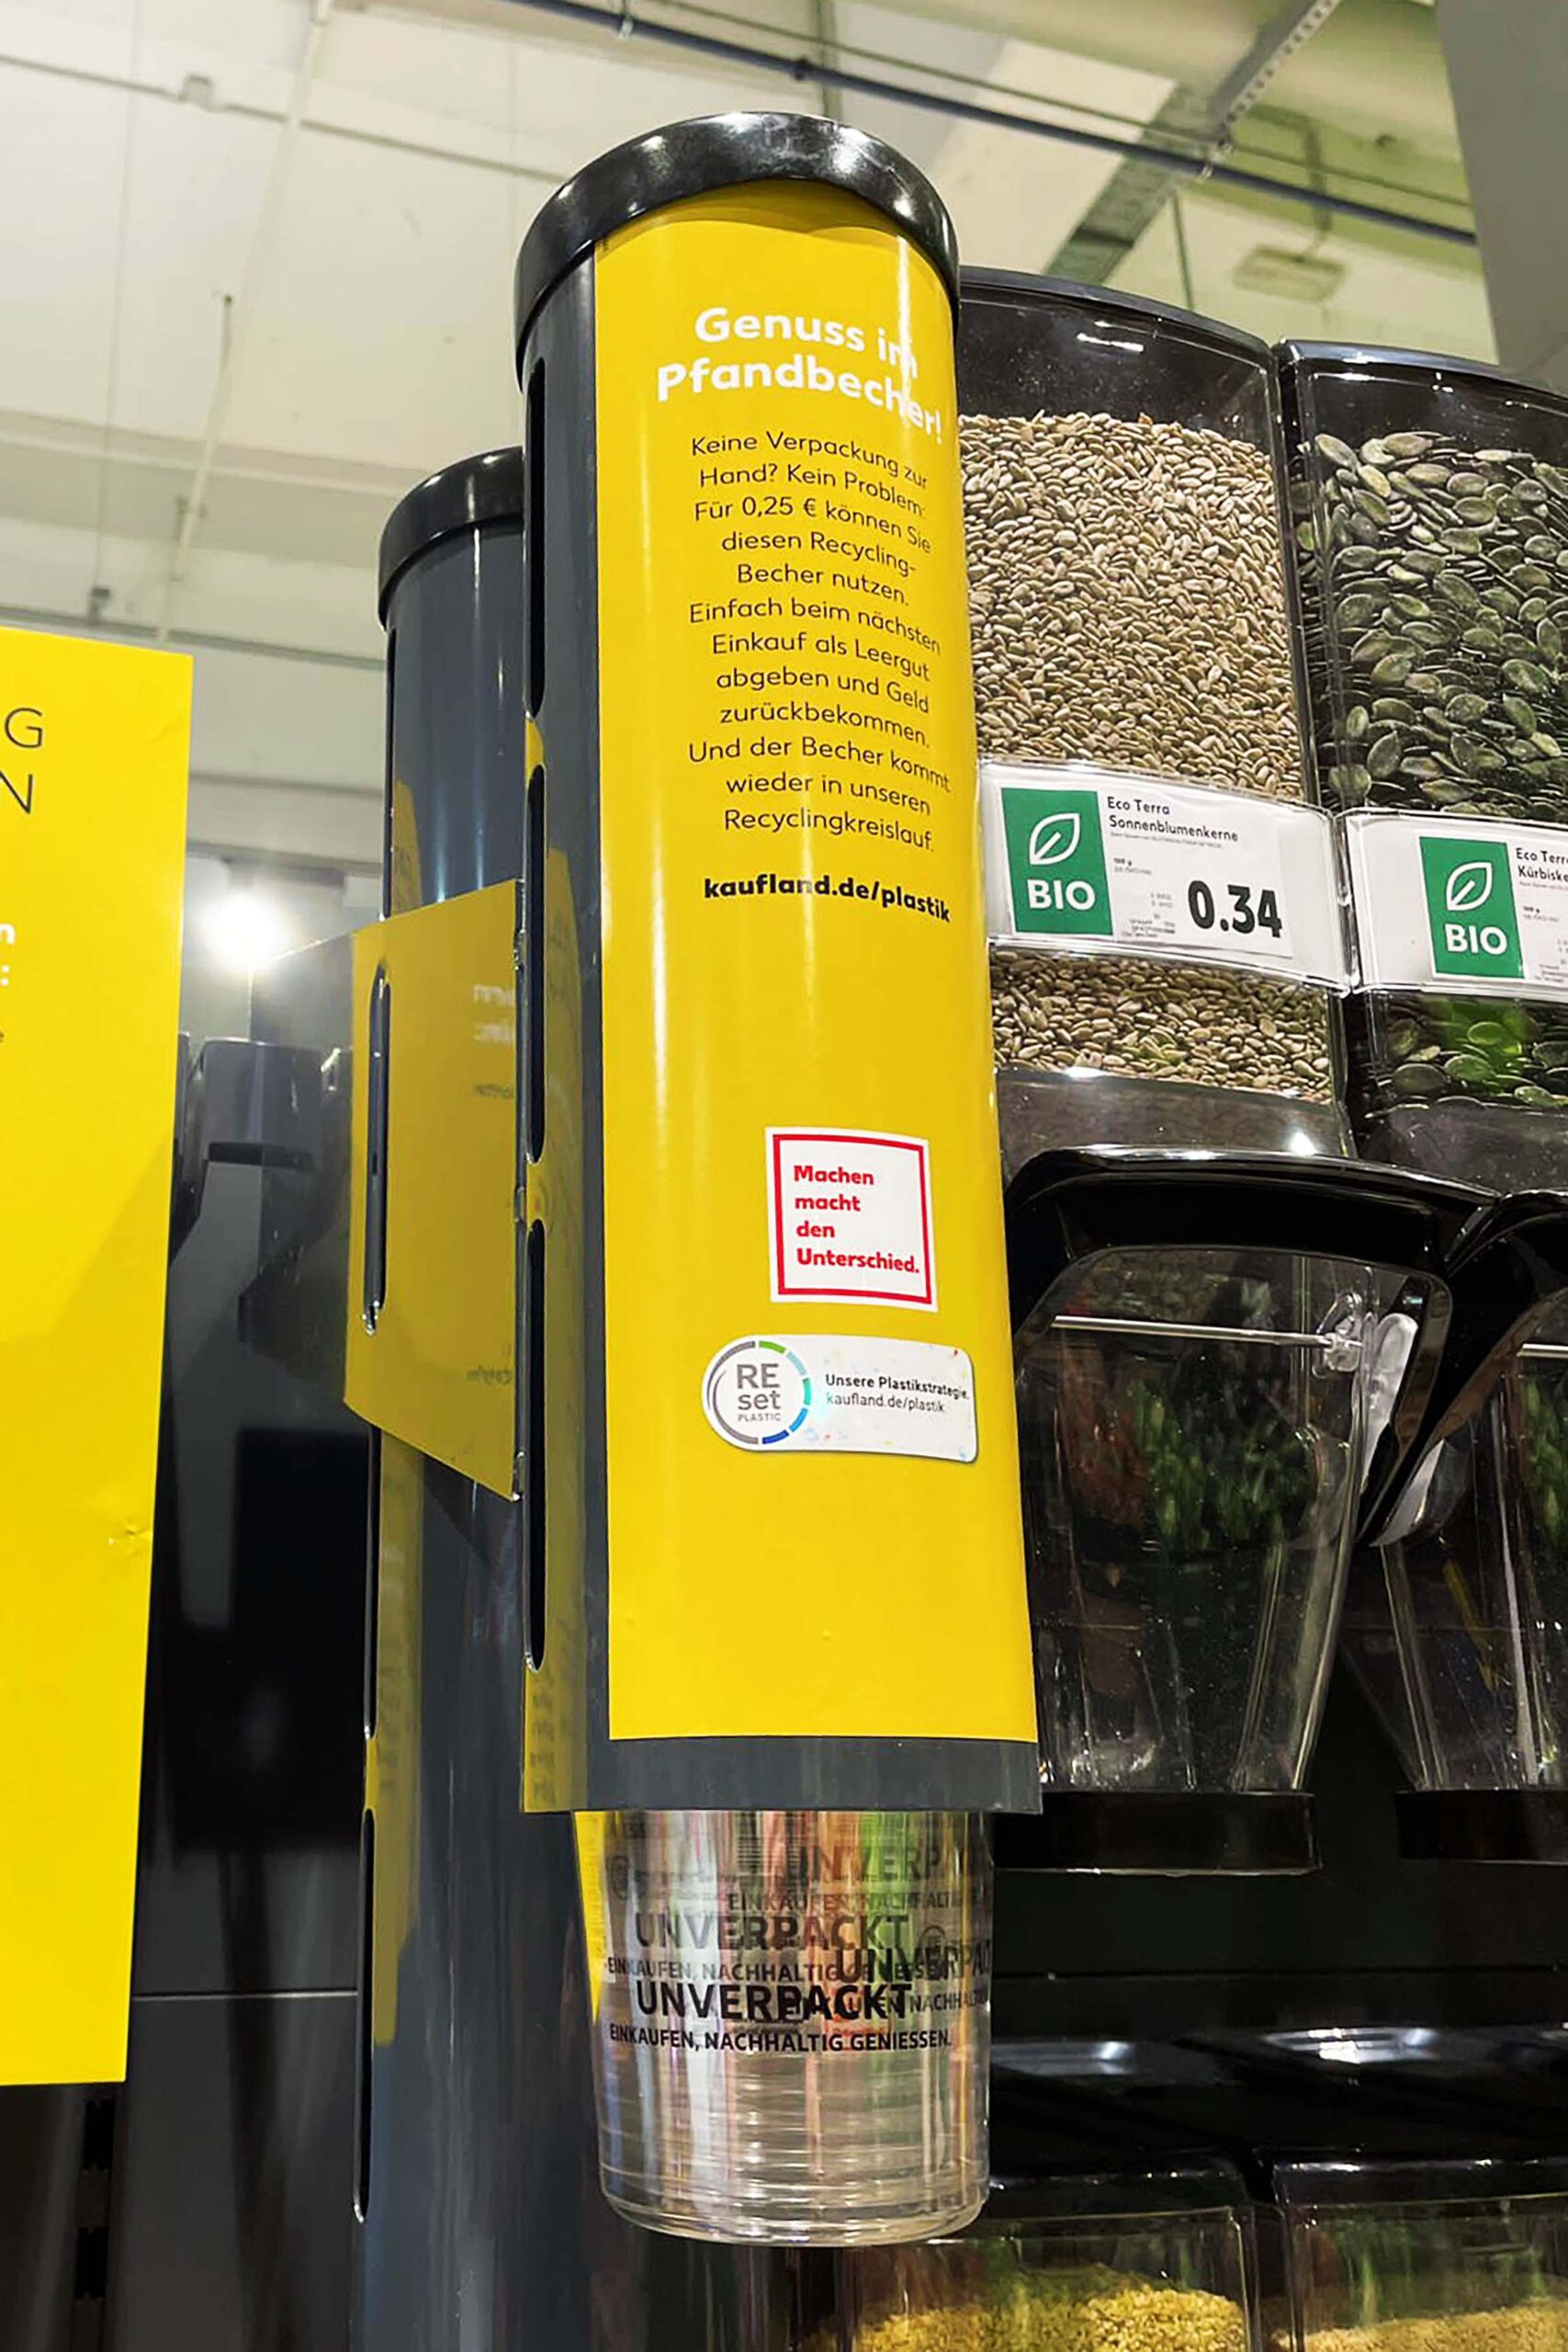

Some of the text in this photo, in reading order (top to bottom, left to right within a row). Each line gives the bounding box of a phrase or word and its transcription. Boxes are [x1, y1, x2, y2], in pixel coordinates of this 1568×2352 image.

[694, 307, 919, 379] Genuss im
[656, 353, 942, 445] Pfandbecher!
[692, 431, 929, 490] Keine Verpackung zur
[700, 463, 777, 489] Hand?
[787, 464, 837, 488] Kein
[694, 496, 931, 554] Für 0,25 € können Sie
[721, 531, 917, 578] diesen Recycling-
[738, 563, 909, 606] Becher nutzen.
[690, 597, 941, 655] Einfach beim nächsten
[713, 632, 931, 682] Einkauf als Leergut
[716, 667, 930, 714] abgeben und Geld
[719, 701, 931, 749] zurückbekommen.
[689, 736, 952, 793] Und der Becher kommt
[726, 773, 931, 816] wieder in unseren
[1107, 796, 1170, 816] Eco Terra
[724, 807, 935, 853] Recyclingkreislauf.
[1109, 814, 1239, 843] Sonnenblumenkerne
[1516, 847, 1538, 863] Eco
[705, 874, 951, 924] kaufland.de/plastik
[1027, 879, 1096, 911] BIO
[1188, 879, 1283, 938] 0.34
[1445, 923, 1508, 956] BIO
[794, 1165, 874, 1186] Machen
[795, 1194, 861, 1212] macht
[796, 1220, 836, 1238] den
[796, 1248, 920, 1274] Unterschied.
[736, 1363, 780, 1389] RE
[826, 1374, 874, 1388] Unsere
[738, 1389, 782, 1411] set
[738, 1413, 781, 1422] PLASTIC
[827, 1392, 945, 1413] kaufland.de/plastik
[636, 1912, 909, 1951] UNVERPACKT
[703, 1963, 838, 1982] NACHHALTIG
[637, 1981, 912, 2021] UNVERPACKT
[609, 2023, 953, 2052] EINKAUFEN, NACHHALTIG GENIESSEN.
